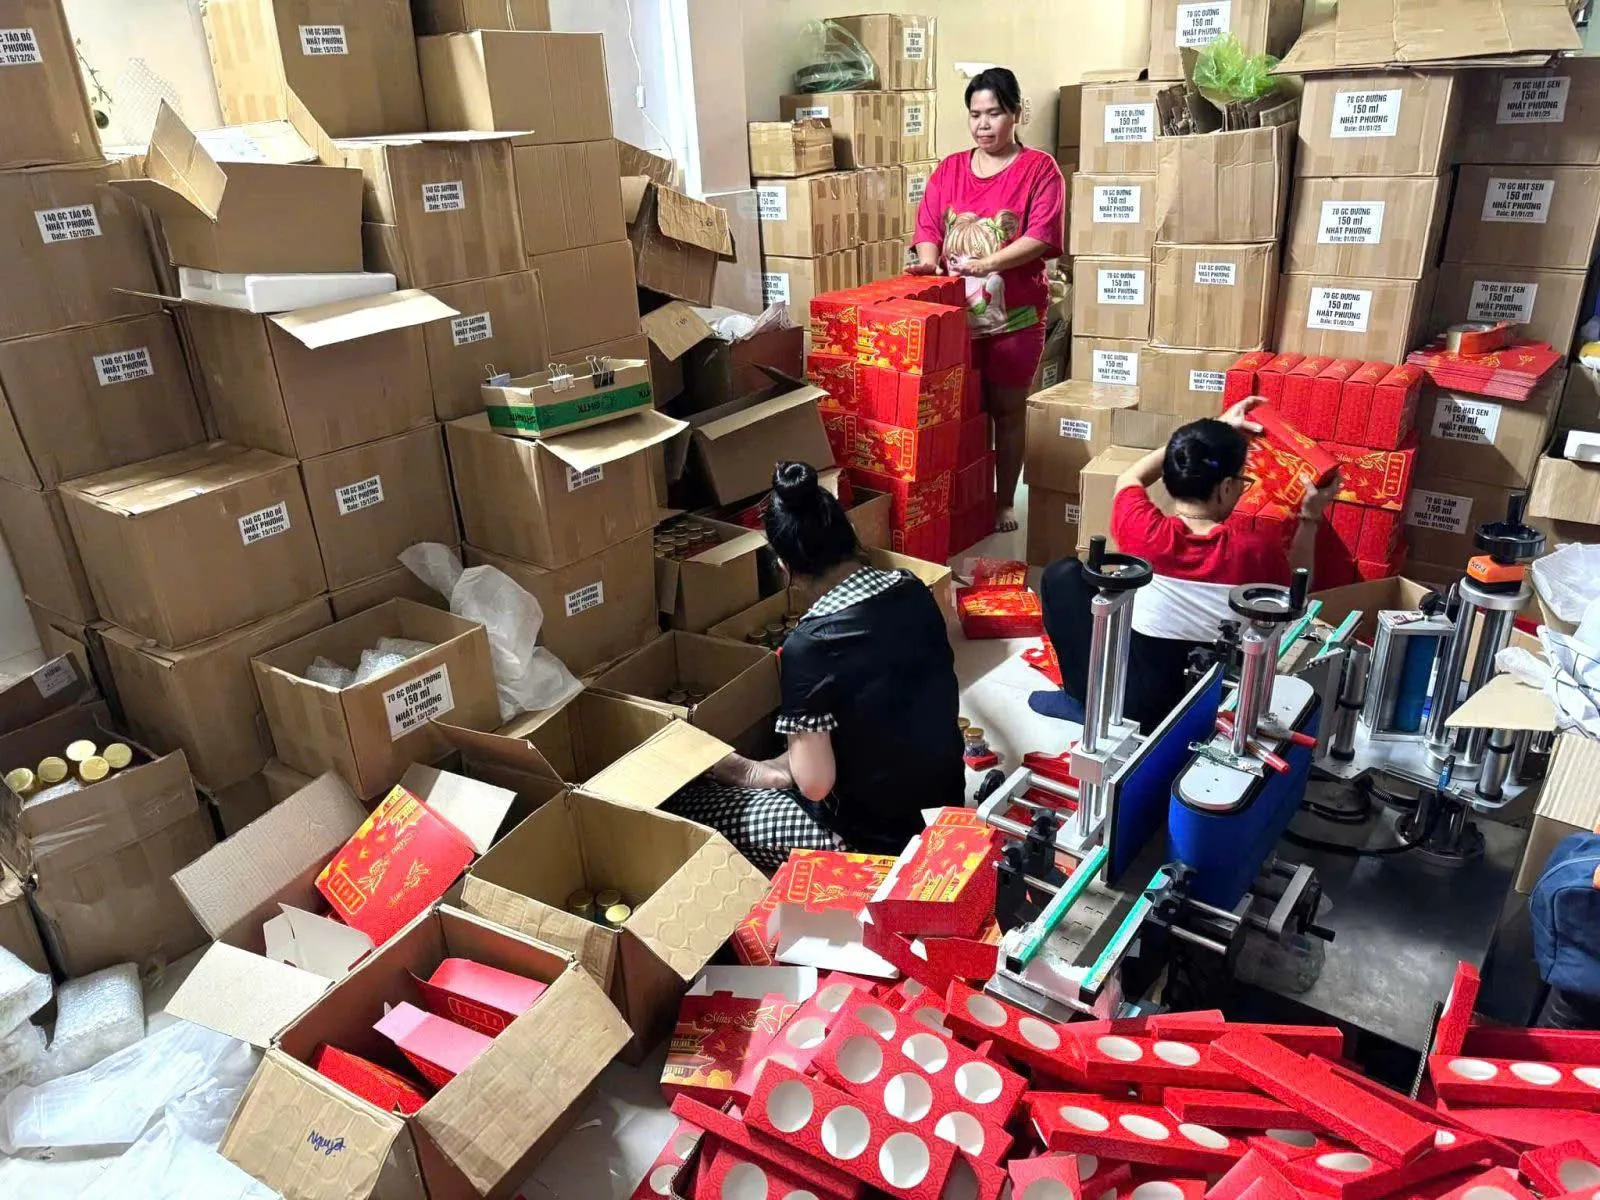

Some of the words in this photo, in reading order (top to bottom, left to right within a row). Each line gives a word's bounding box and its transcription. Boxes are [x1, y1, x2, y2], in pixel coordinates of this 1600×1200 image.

[1193, 18, 1203, 27] 150
[1205, 18, 1213, 26] ml
[7, 54, 35, 62] 15/12/24
[1522, 90, 1536, 100] 150
[1538, 90, 1548, 99] ml
[1347, 96, 1354, 104] 70
[1353, 104, 1366, 113] 150
[1369, 104, 1378, 113] ml
[1506, 191, 1520, 200] 150
[1522, 191, 1532, 200] ml
[43, 213, 56, 222] 140
[58, 212, 67, 221] GC
[1338, 216, 1352, 225] 150
[1353, 217, 1362, 225] ml
[51, 231, 68, 240] Date:
[69, 229, 94, 238] 15/12/24
[1489, 293, 1502, 301] 150
[1504, 294, 1514, 302] ml
[1328, 300, 1341, 309] 150
[1342, 301, 1352, 310] ml
[101, 358, 113, 367] 140
[1475, 408, 1489, 416] SEN
[1452, 414, 1465, 423] 150
[1468, 416, 1478, 425] ml
[1427, 504, 1440, 513] 150
[242, 517, 252, 526] 140
[253, 514, 261, 522] GC
[387, 694, 396, 704] 70
[396, 689, 405, 698] GC
[404, 691, 419, 707] 150
[420, 687, 430, 698] ml
